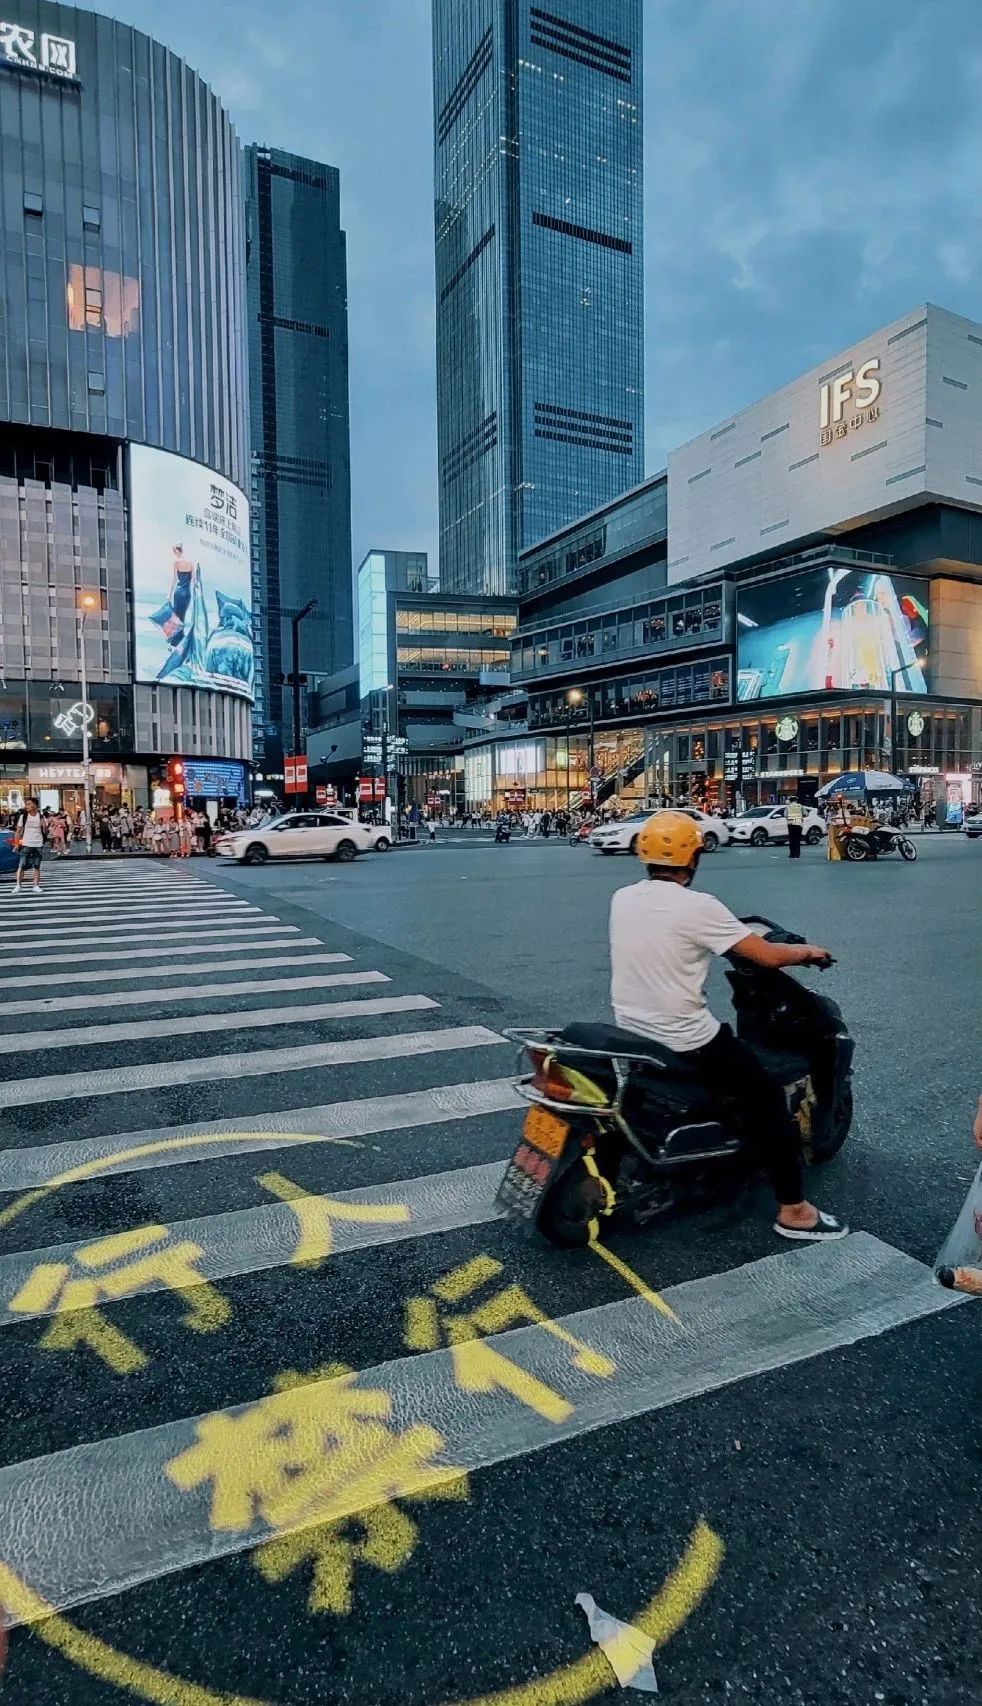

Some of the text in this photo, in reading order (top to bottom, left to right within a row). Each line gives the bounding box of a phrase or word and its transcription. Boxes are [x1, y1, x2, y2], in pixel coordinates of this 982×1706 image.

[0, 22, 76, 74] 农网
[820, 359, 882, 429] IFS
[820, 406, 880, 447] 国金中心
[210, 484, 237, 521] 梦洁
[8, 1170, 411, 1374] 行人
